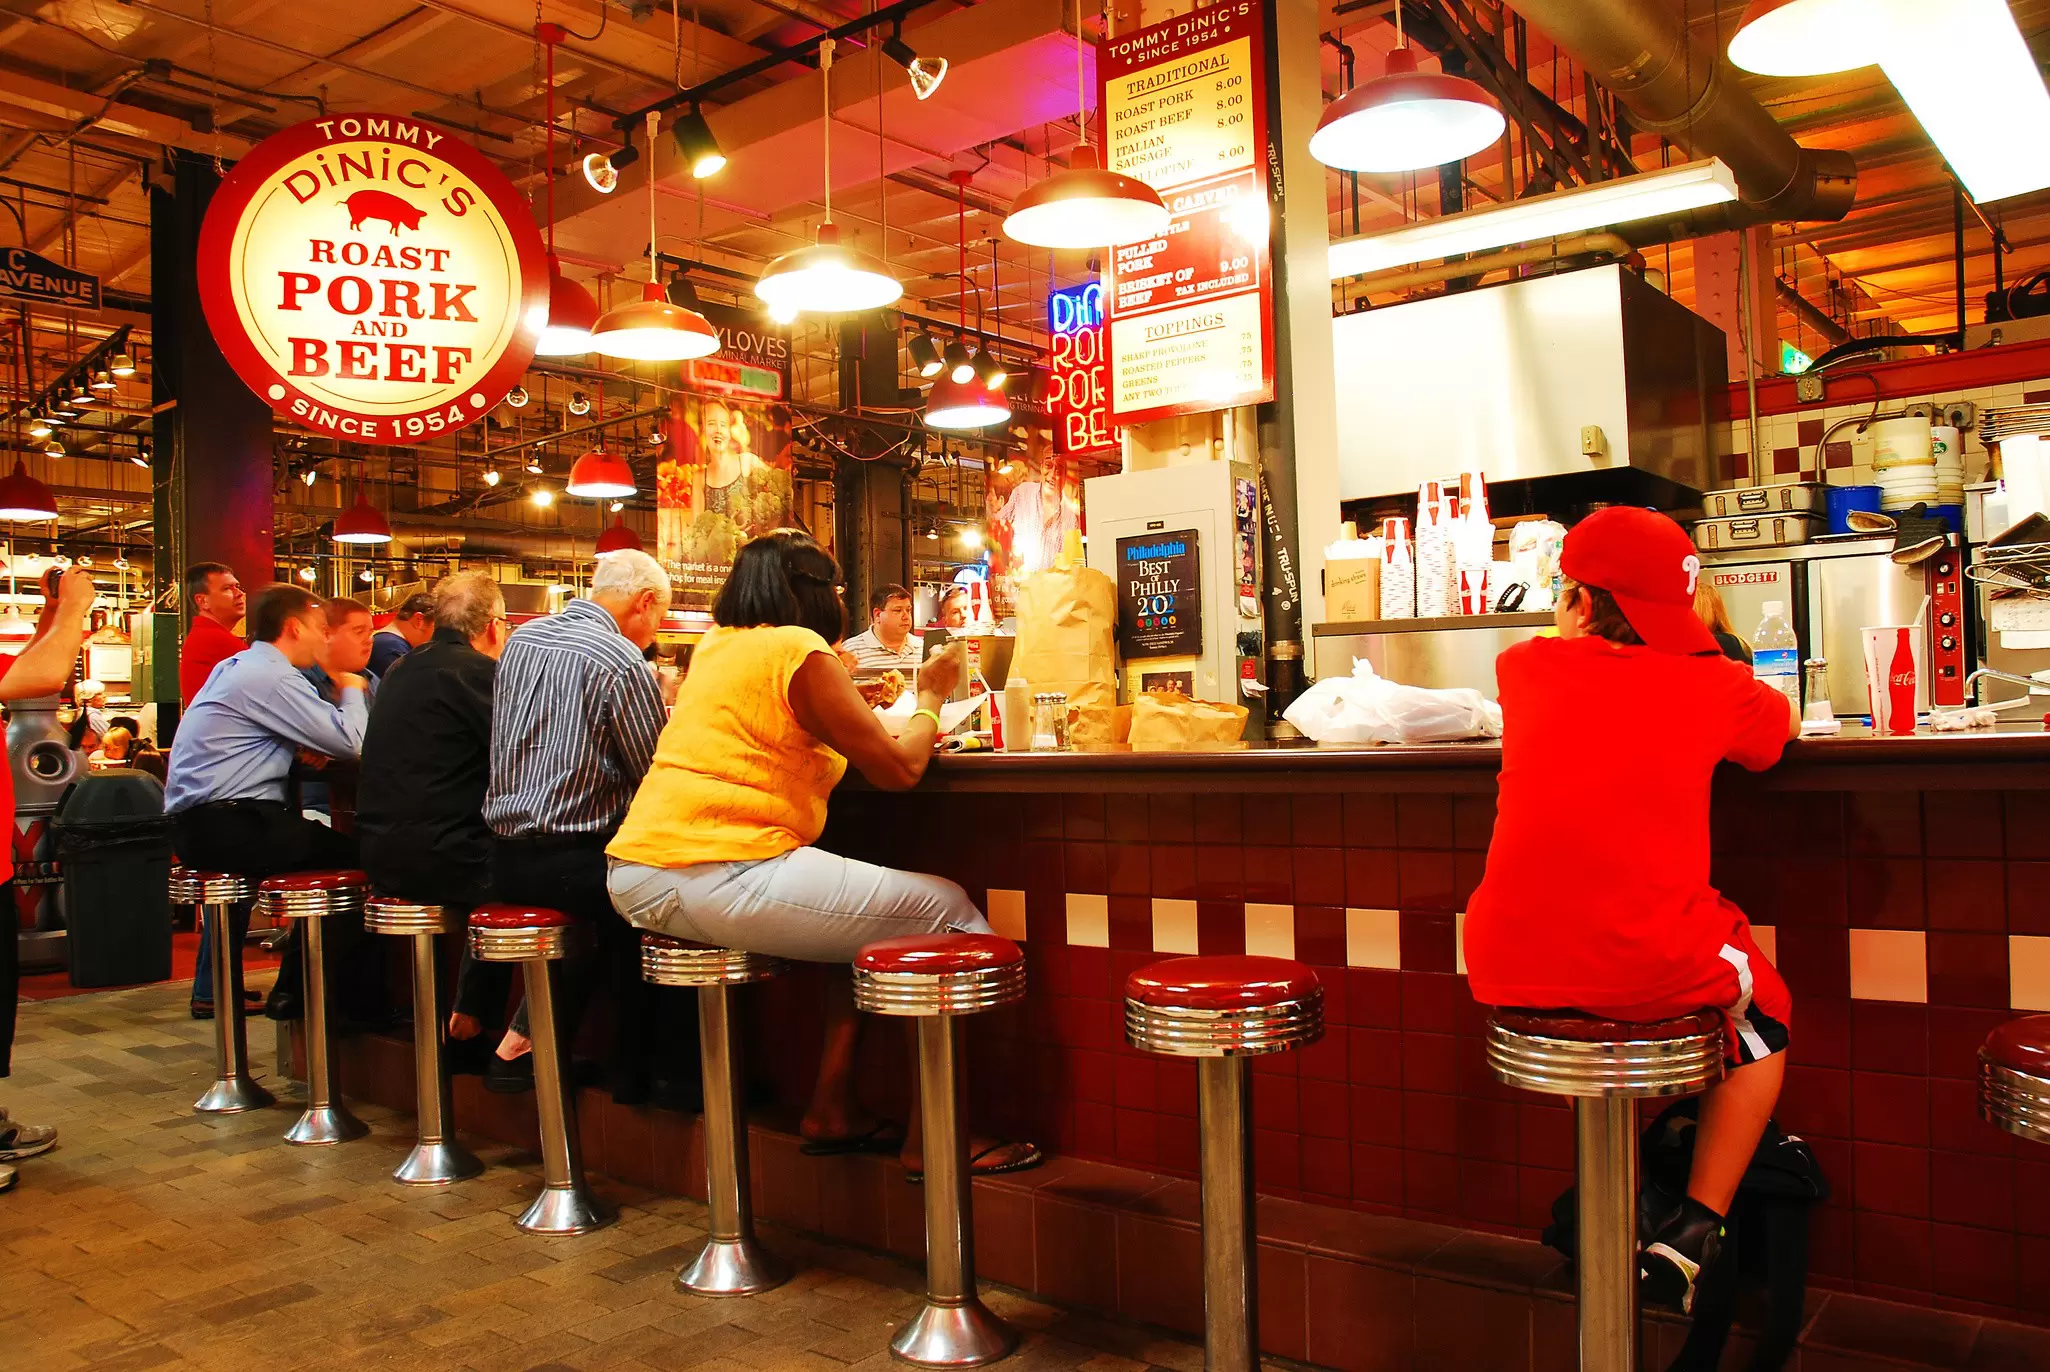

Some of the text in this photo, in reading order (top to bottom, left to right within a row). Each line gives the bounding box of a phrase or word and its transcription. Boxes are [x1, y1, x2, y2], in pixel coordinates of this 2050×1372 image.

[1109, 28, 1170, 59] TOMMY
[1138, 28, 1218, 63] SINCE 1954
[1127, 53, 1230, 94] TRADITIONAL
[1115, 75, 1242, 122] ROAST PORK 8.00
[1115, 94, 1243, 140] ROAST BEEF 8.00
[316, 117, 444, 150] TOMMY
[1116, 112, 1244, 158] ITALIAN 8.00
[1116, 146, 1173, 171] SAUSAGE
[1218, 145, 1245, 161] 8.00
[8, 249, 27, 271] C
[309, 238, 451, 272] ROAST
[1117, 239, 1168, 263] PULLED
[1117, 256, 1249, 275] PORK 9.00
[1175, 267, 1195, 282] OF
[0, 269, 93, 298] AVENUE
[1175, 273, 1249, 297] TAX INCLUDED
[277, 271, 479, 323] PORK
[352, 320, 408, 337] AND
[1144, 312, 1224, 339] TOPPINGS
[727, 328, 788, 359] LOVES
[1121, 350, 1151, 363] SHARP
[1152, 339, 1209, 357] PROVOLONE
[287, 336, 473, 385] BEEF
[750, 355, 788, 370] MARKET
[1122, 362, 1163, 376] ROASTED
[1165, 353, 1207, 369] PEPPERS
[1122, 376, 1160, 389] GREENS
[1122, 391, 1143, 403] ANY
[1143, 387, 1163, 399] TWO
[291, 398, 466, 438] SINCE 1954
[1127, 541, 1186, 561] Philadelphia
[1716, 572, 1776, 585] BLODGETT
[1137, 594, 1175, 616] 2002
